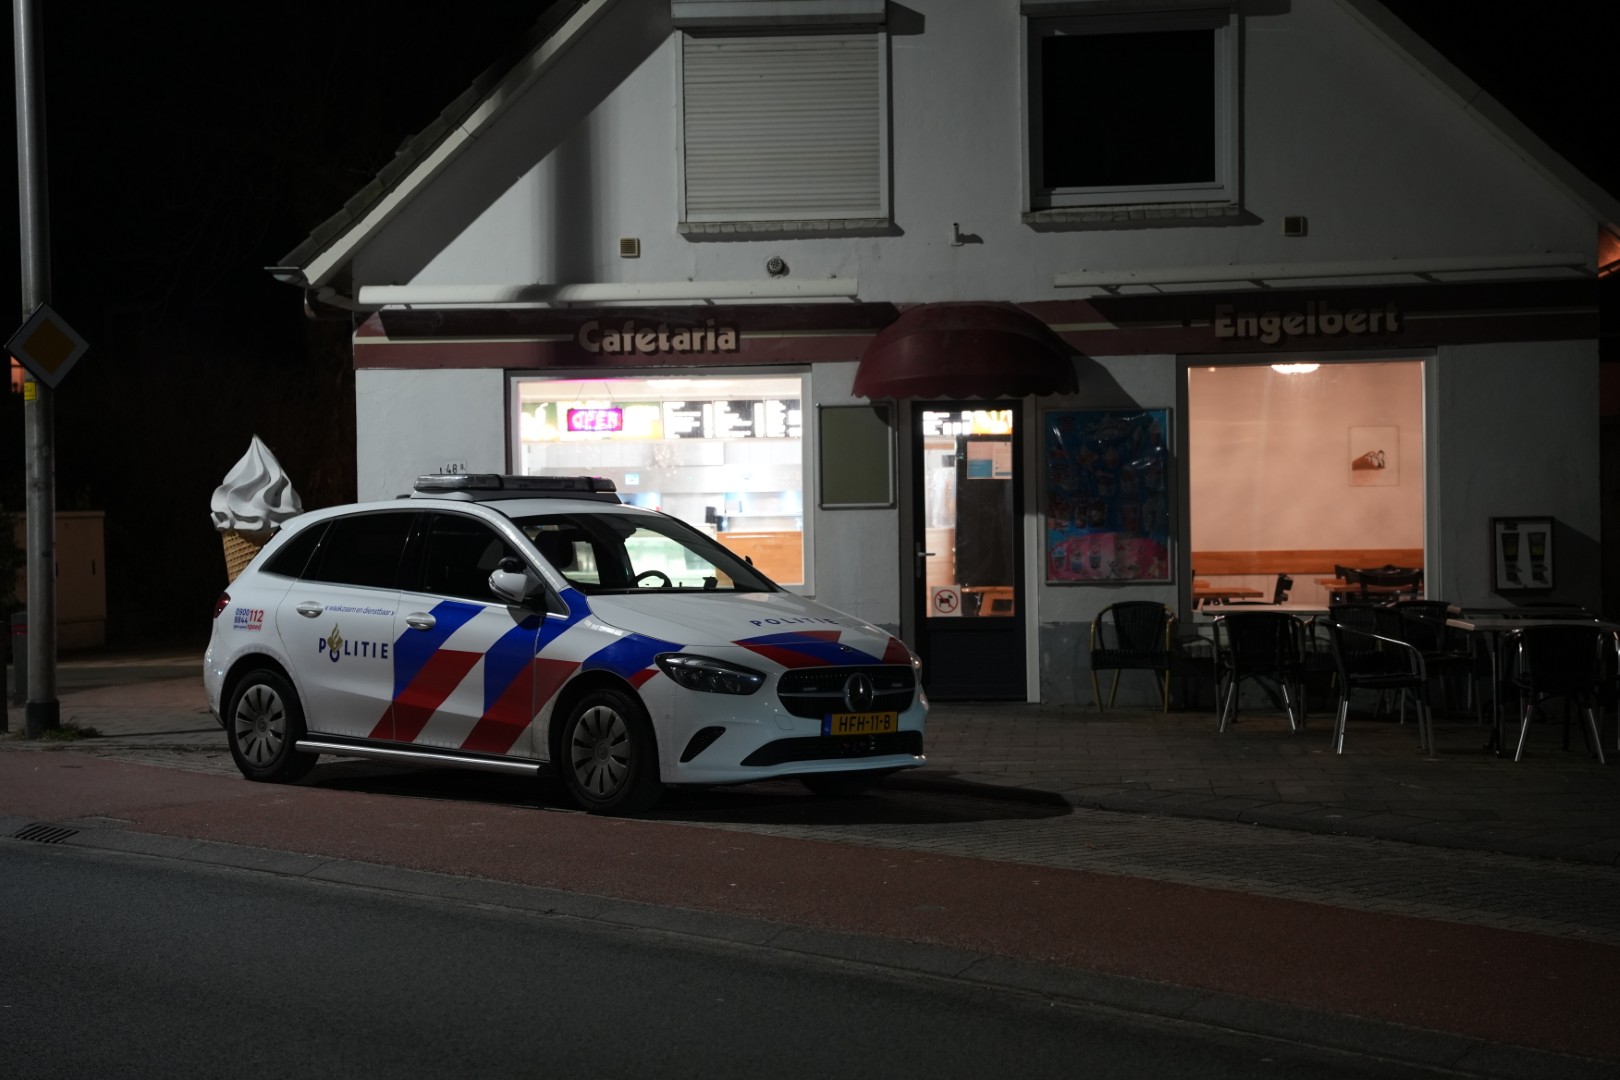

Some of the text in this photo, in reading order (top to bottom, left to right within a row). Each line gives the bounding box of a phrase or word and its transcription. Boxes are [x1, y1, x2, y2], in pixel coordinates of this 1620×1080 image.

[1214, 300, 1400, 345] Engelbert
[578, 318, 737, 353] Cafetaria
[571, 410, 619, 430] OPEN
[250, 609, 264, 622] 112
[749, 617, 839, 627] POLITIE
[318, 637, 389, 663] POLITIE
[838, 714, 891, 732] HFH-11-B
